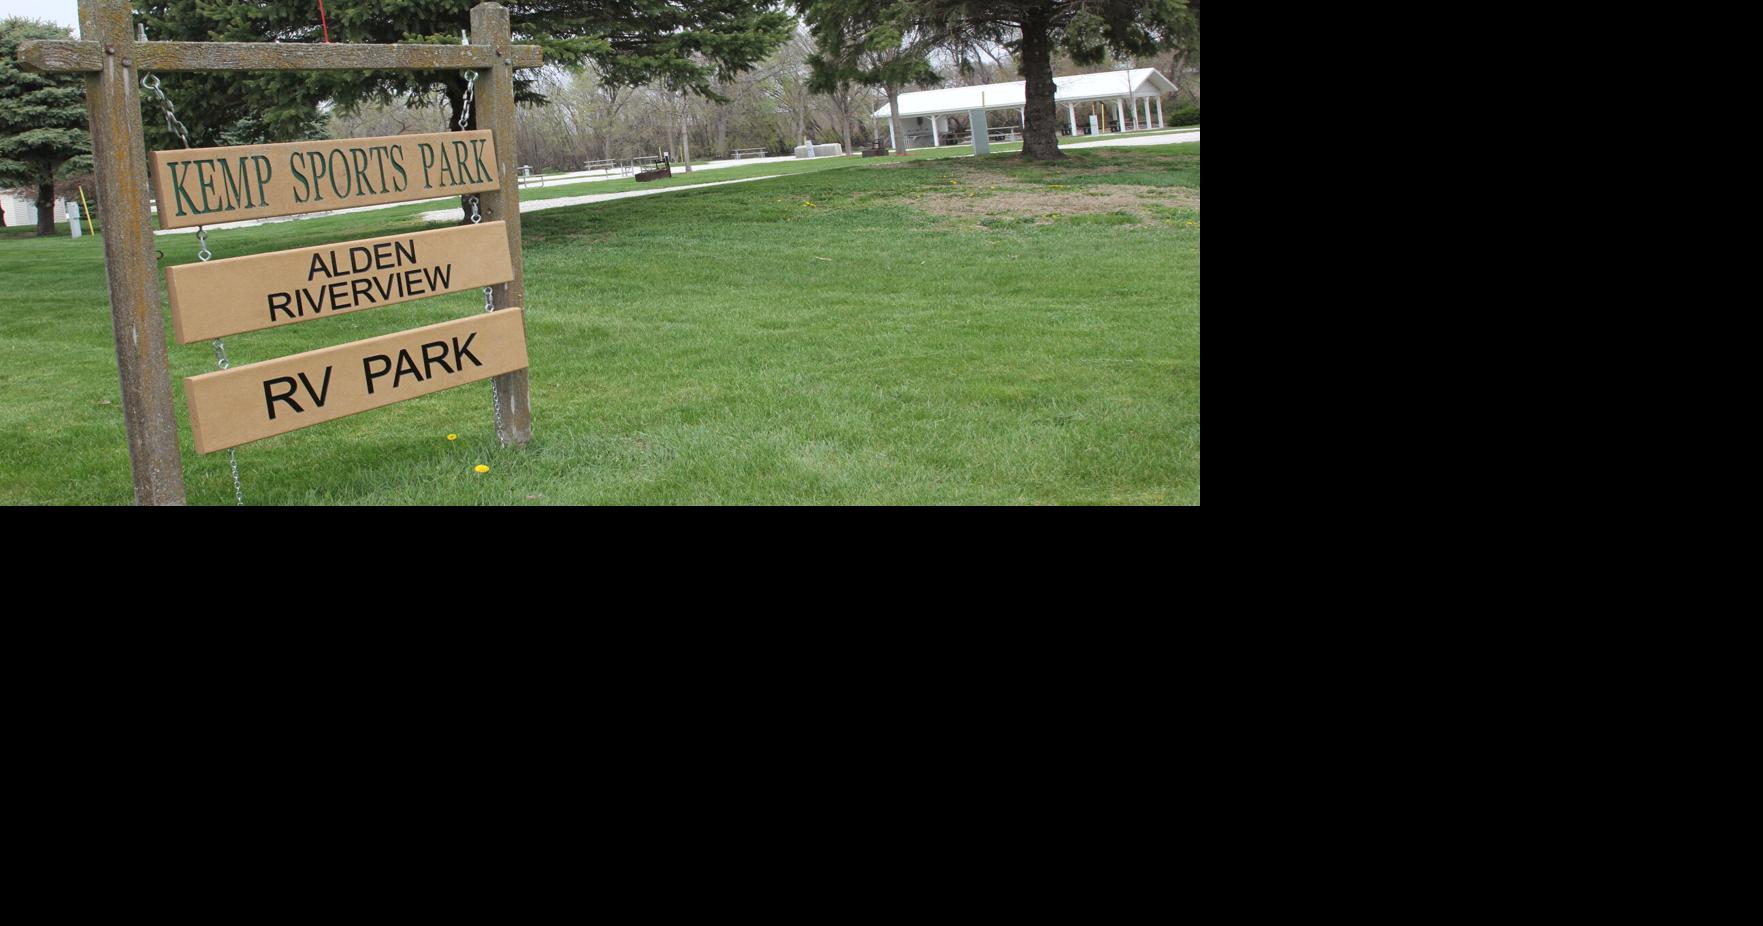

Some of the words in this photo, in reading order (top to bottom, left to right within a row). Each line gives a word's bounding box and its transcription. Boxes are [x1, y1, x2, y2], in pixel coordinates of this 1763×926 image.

[166, 155, 273, 218] KEMP
[289, 144, 408, 203] SPORTS
[417, 138, 493, 189] PARK
[267, 264, 452, 322] RIVERVIEW
[307, 239, 417, 281] ALDEN
[262, 366, 332, 420] RV
[362, 332, 483, 395] PARK
